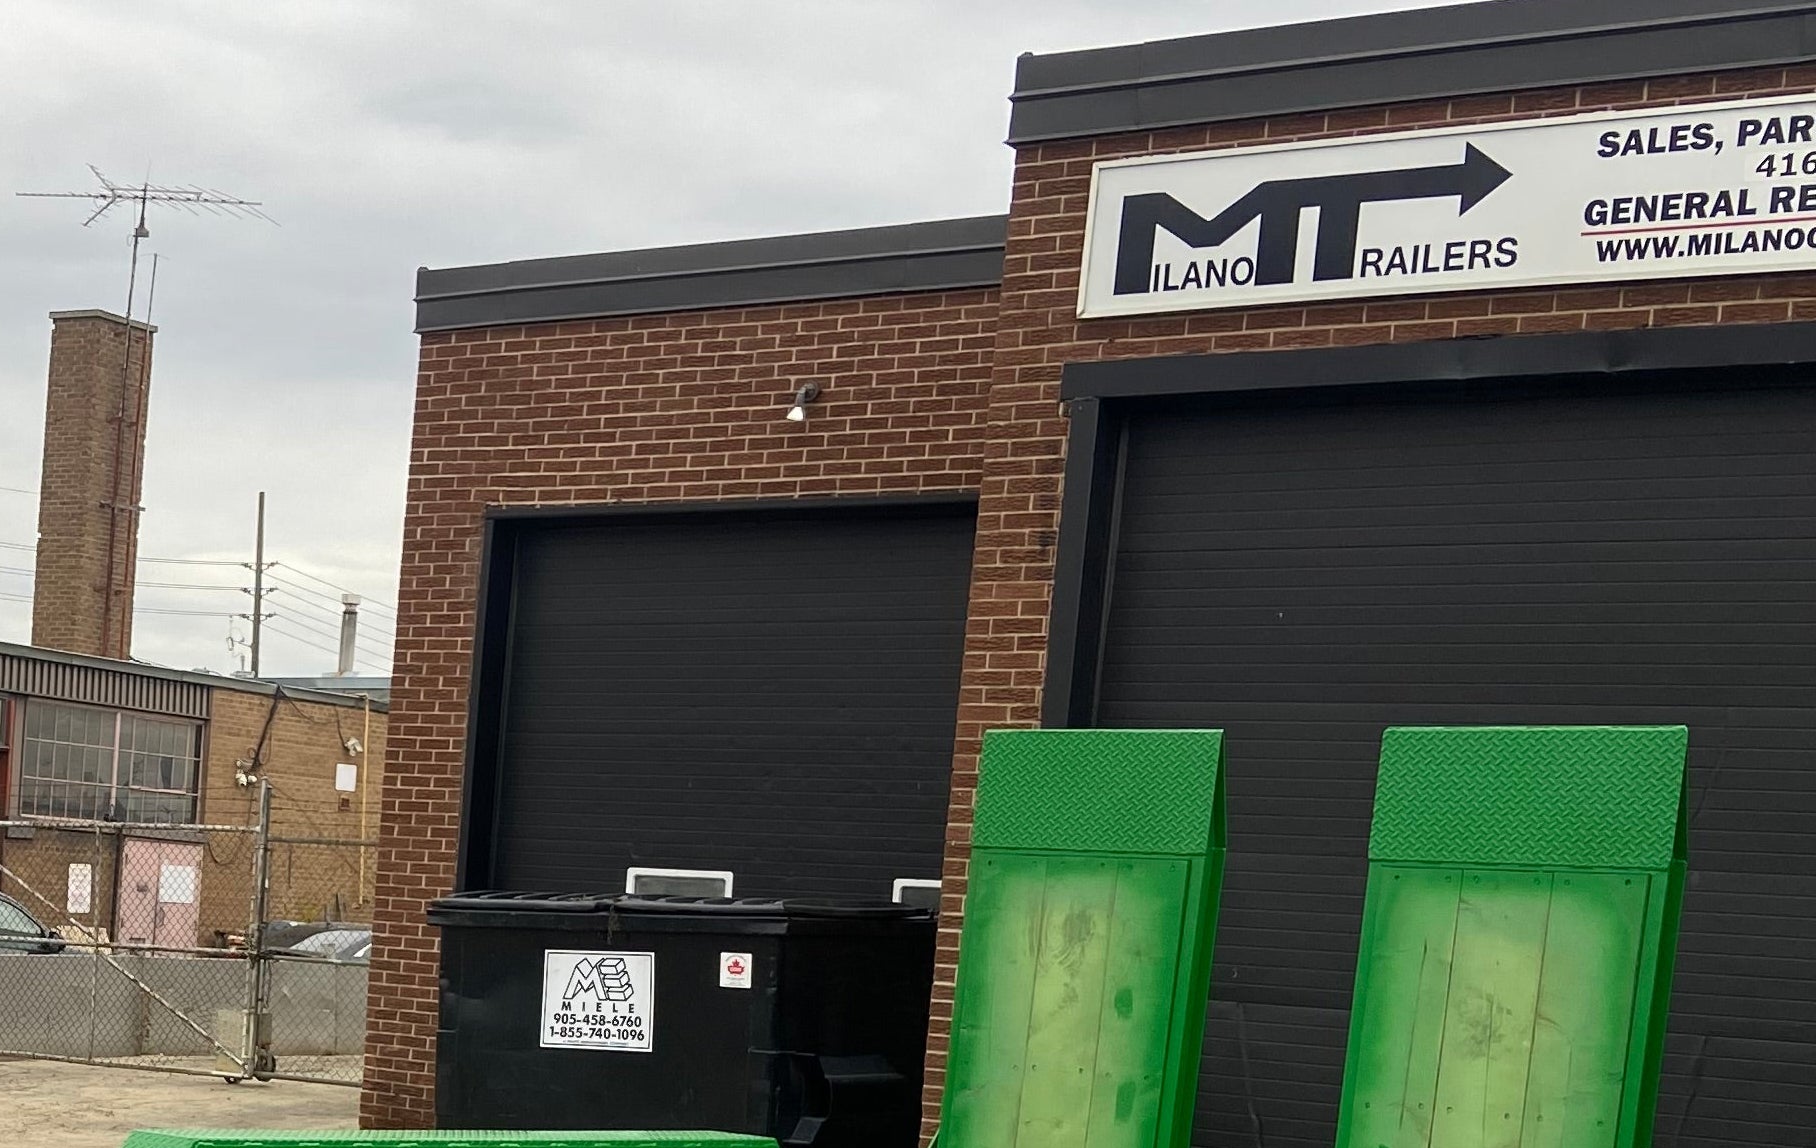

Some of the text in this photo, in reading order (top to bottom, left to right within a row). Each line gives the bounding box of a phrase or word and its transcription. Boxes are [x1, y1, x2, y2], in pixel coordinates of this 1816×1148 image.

[1596, 114, 1815, 156] SALES, PAR
[1755, 151, 1816, 178] 416
[1583, 184, 1816, 227] GENERAL RE
[1113, 181, 1298, 296] MILANO
[553, 1012, 643, 1028] 905-458-6760
[561, 1001, 635, 1013] MIELE
[549, 1025, 646, 1042] 1-855-740-1096
